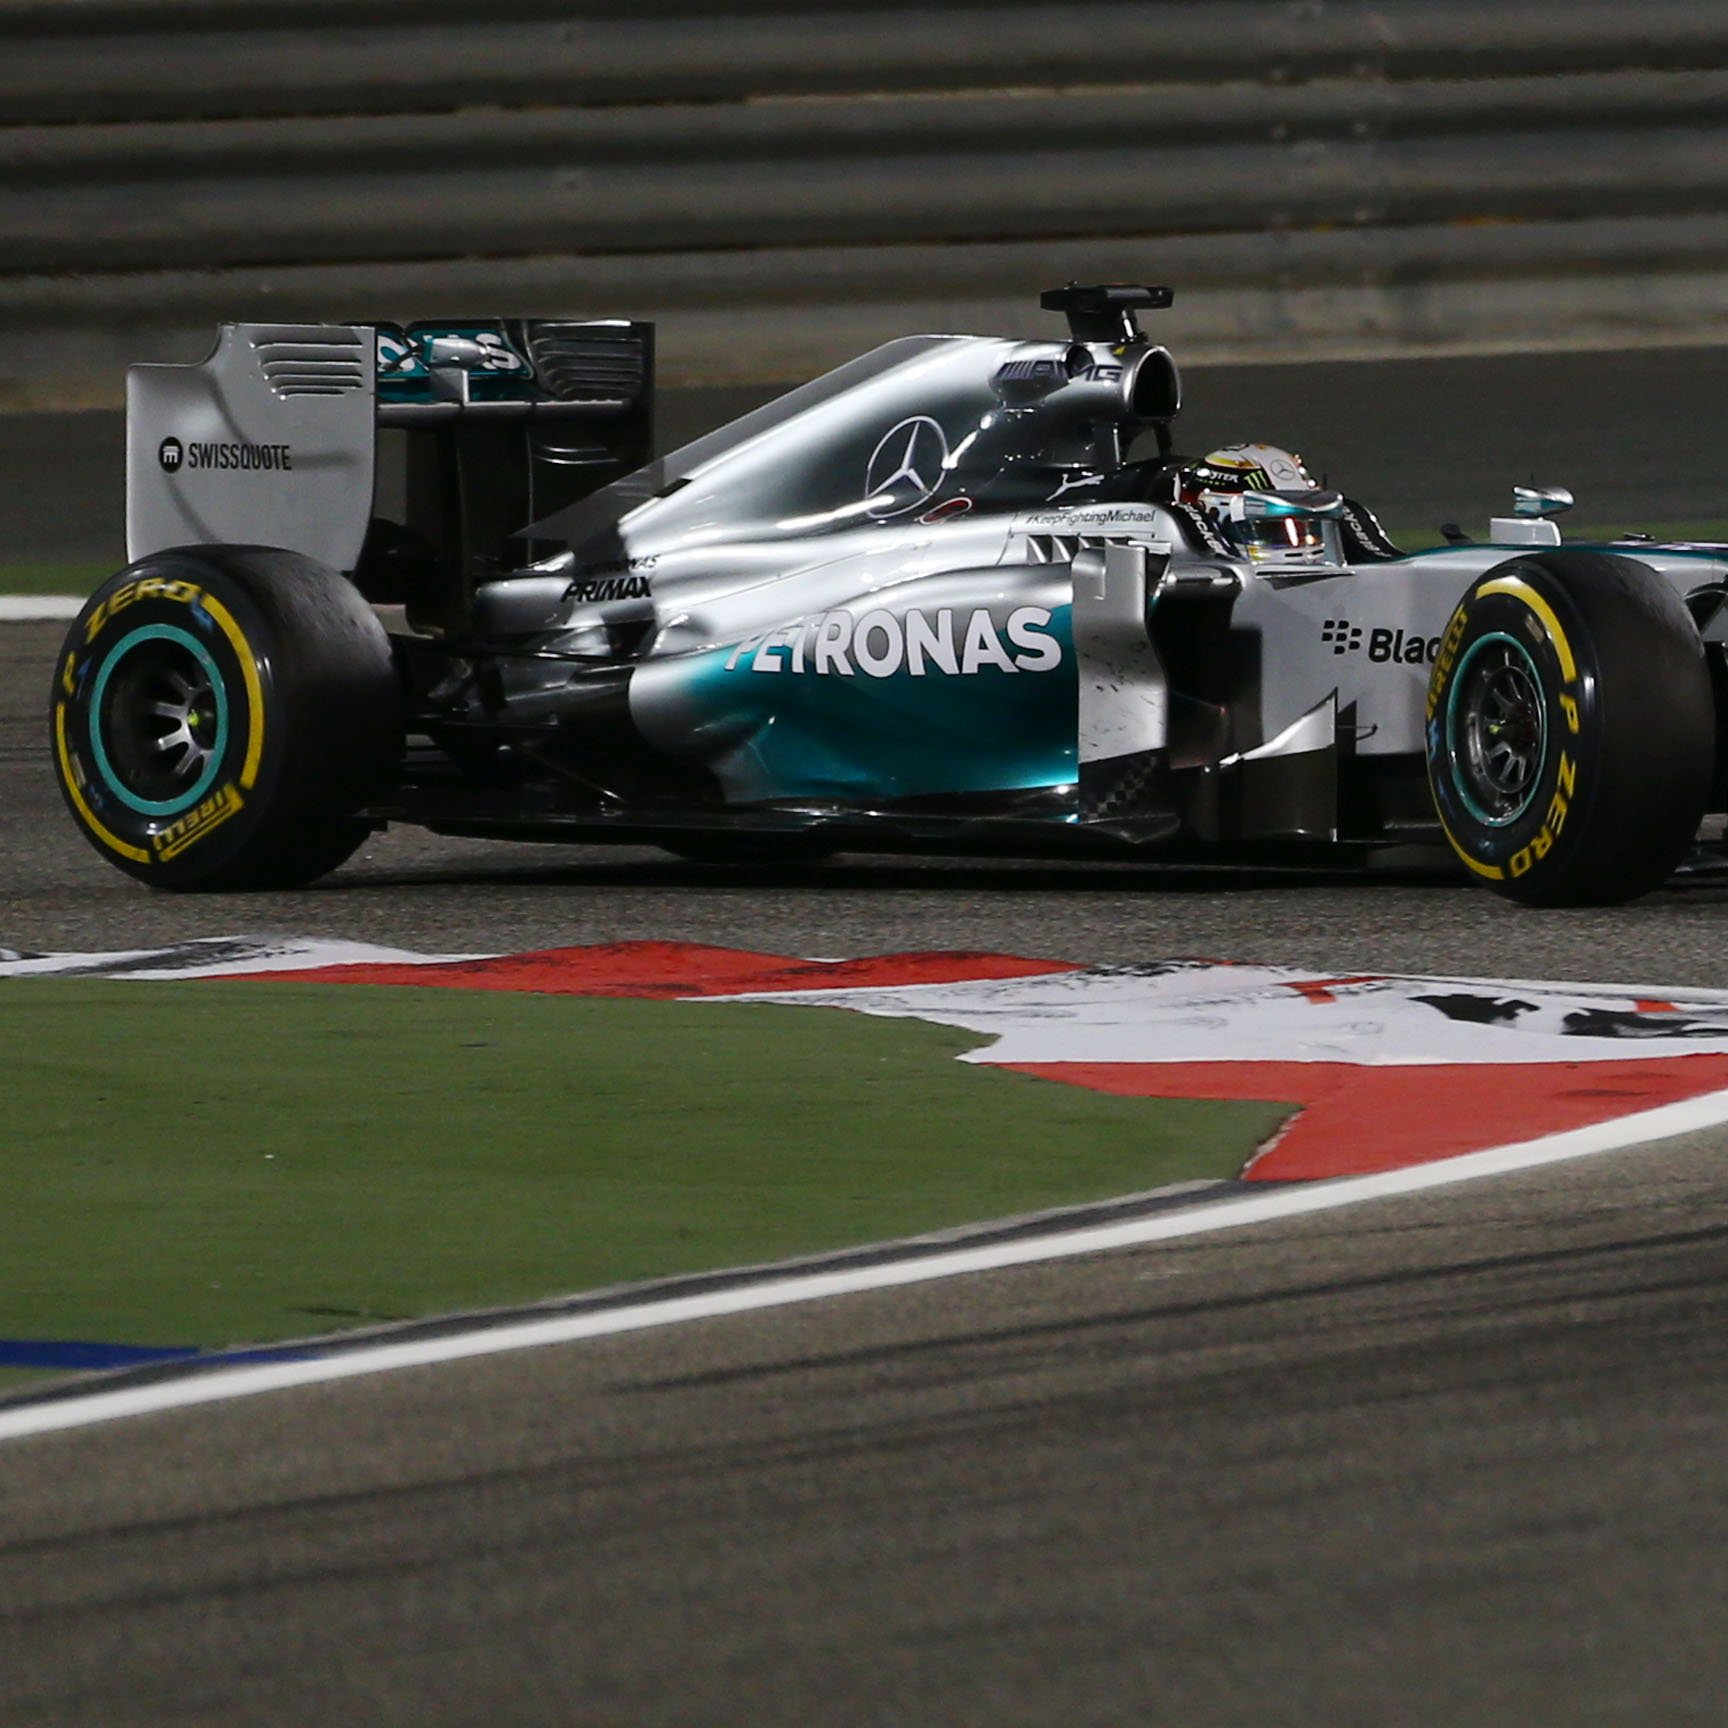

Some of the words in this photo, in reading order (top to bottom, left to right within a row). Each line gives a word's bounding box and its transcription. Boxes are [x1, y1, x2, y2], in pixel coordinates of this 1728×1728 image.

[188, 442, 292, 471] SWISSQUOTE
[1025, 509, 1156, 529] #KeepFightingMichael
[84, 577, 201, 645] ZERO
[560, 575, 653, 604] PRIMAX
[723, 606, 1064, 677] PETRONAS
[1559, 693, 1579, 734] P
[152, 781, 246, 863] PIRELLI
[1509, 750, 1577, 879] ZERO
